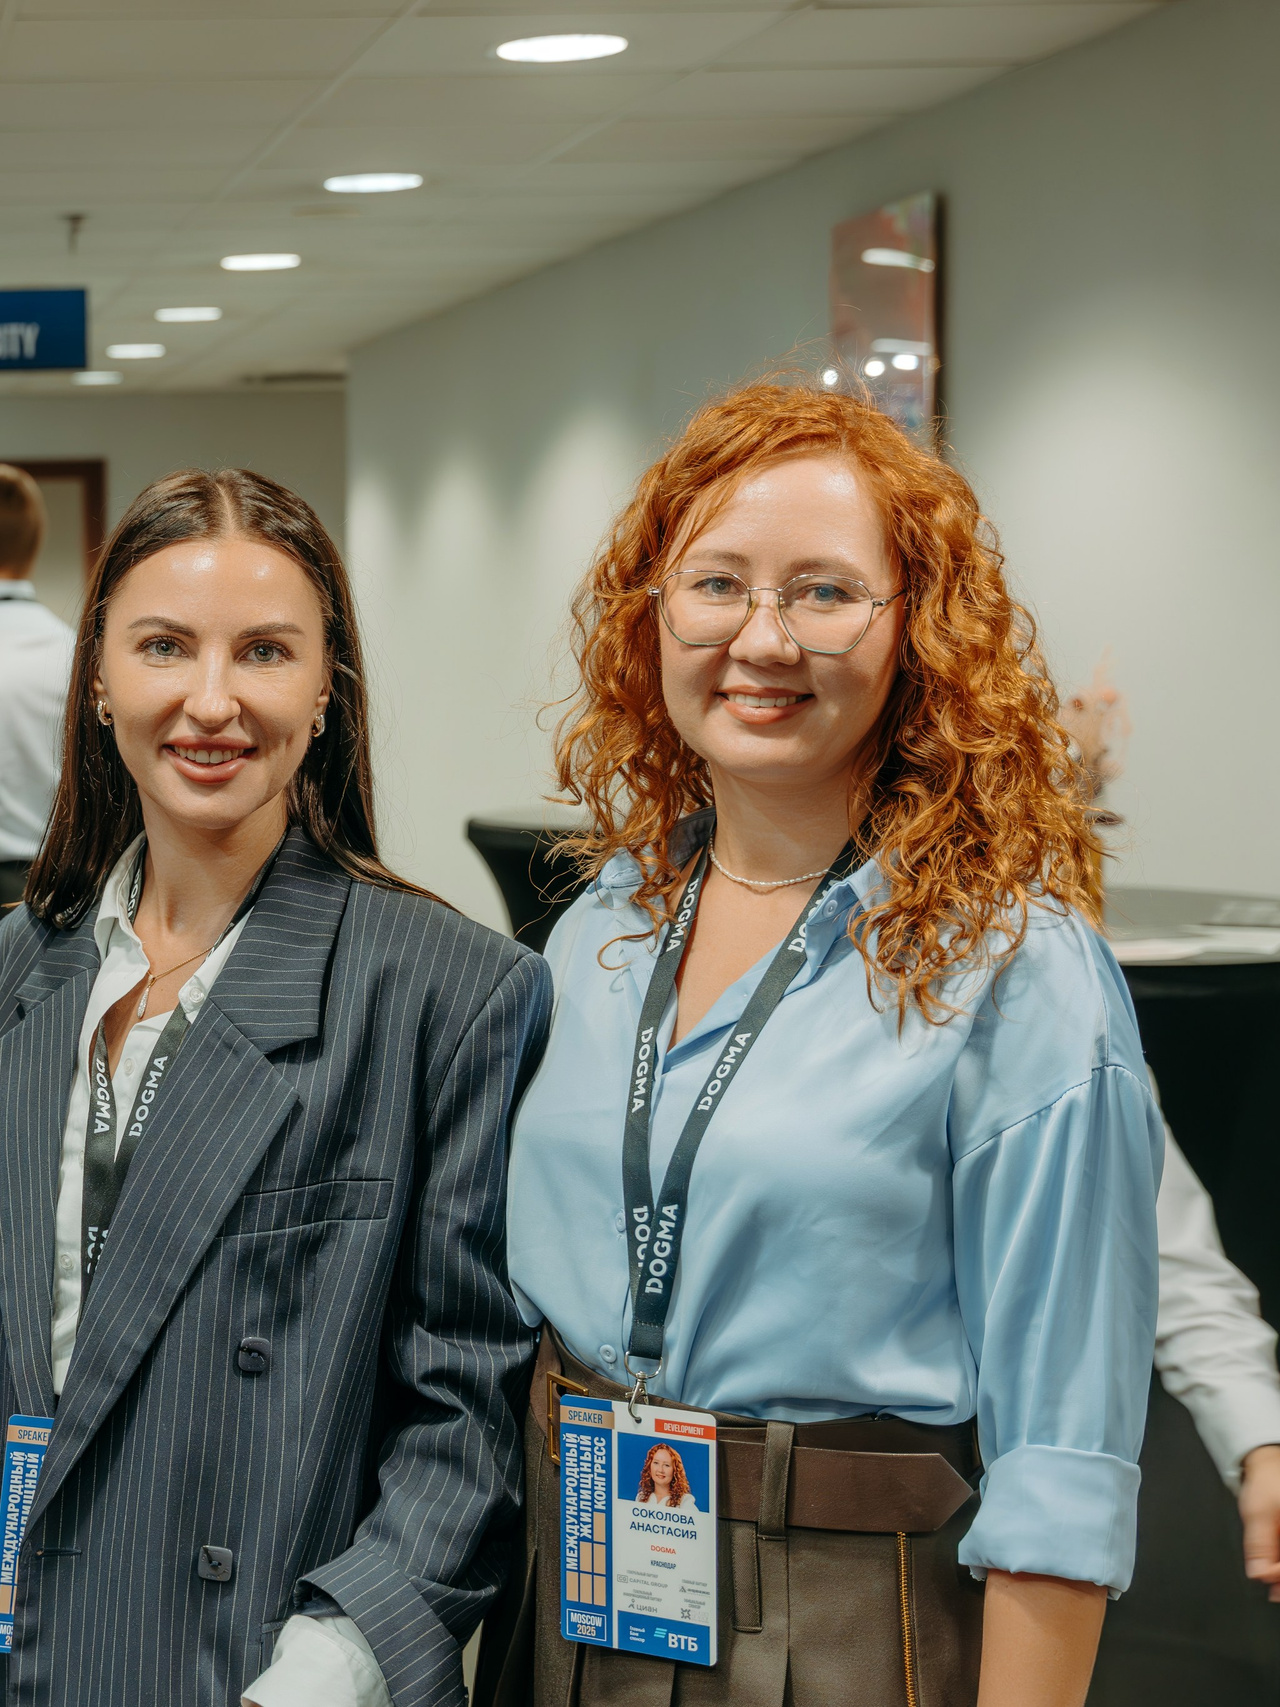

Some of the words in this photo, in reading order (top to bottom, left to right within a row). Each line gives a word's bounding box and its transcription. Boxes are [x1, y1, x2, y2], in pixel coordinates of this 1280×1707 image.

[666, 877, 699, 952] DOGMA
[93, 1058, 111, 1134] DOGMA
[128, 1055, 169, 1137] DOGMA
[631, 1026, 654, 1113] DOGMA
[697, 1032, 752, 1111] DOGMA
[632, 1205, 651, 1267] DOG
[644, 1204, 679, 1294] DOGMA
[568, 1410, 603, 1425] SPEAKER
[663, 1422, 705, 1436] DEVELOPMENT
[563, 1433, 579, 1570] МЕЖДУНАРОДНЫЙ
[577, 1435, 593, 1539] ЖИЛИЩНЫЙ
[593, 1436, 606, 1510] КОНГРЕСС
[0, 1451, 25, 1584] МЕЖДУНАРОДНЫЙ
[629, 1521, 697, 1540] АНАСТАСИЯ
[632, 1507, 695, 1526] СОКОЛОВА
[650, 1545, 676, 1554] DOGMA
[570, 1612, 603, 1627] MOSCOW
[577, 1624, 596, 1636] 2025
[668, 1633, 698, 1652] ВТБ
